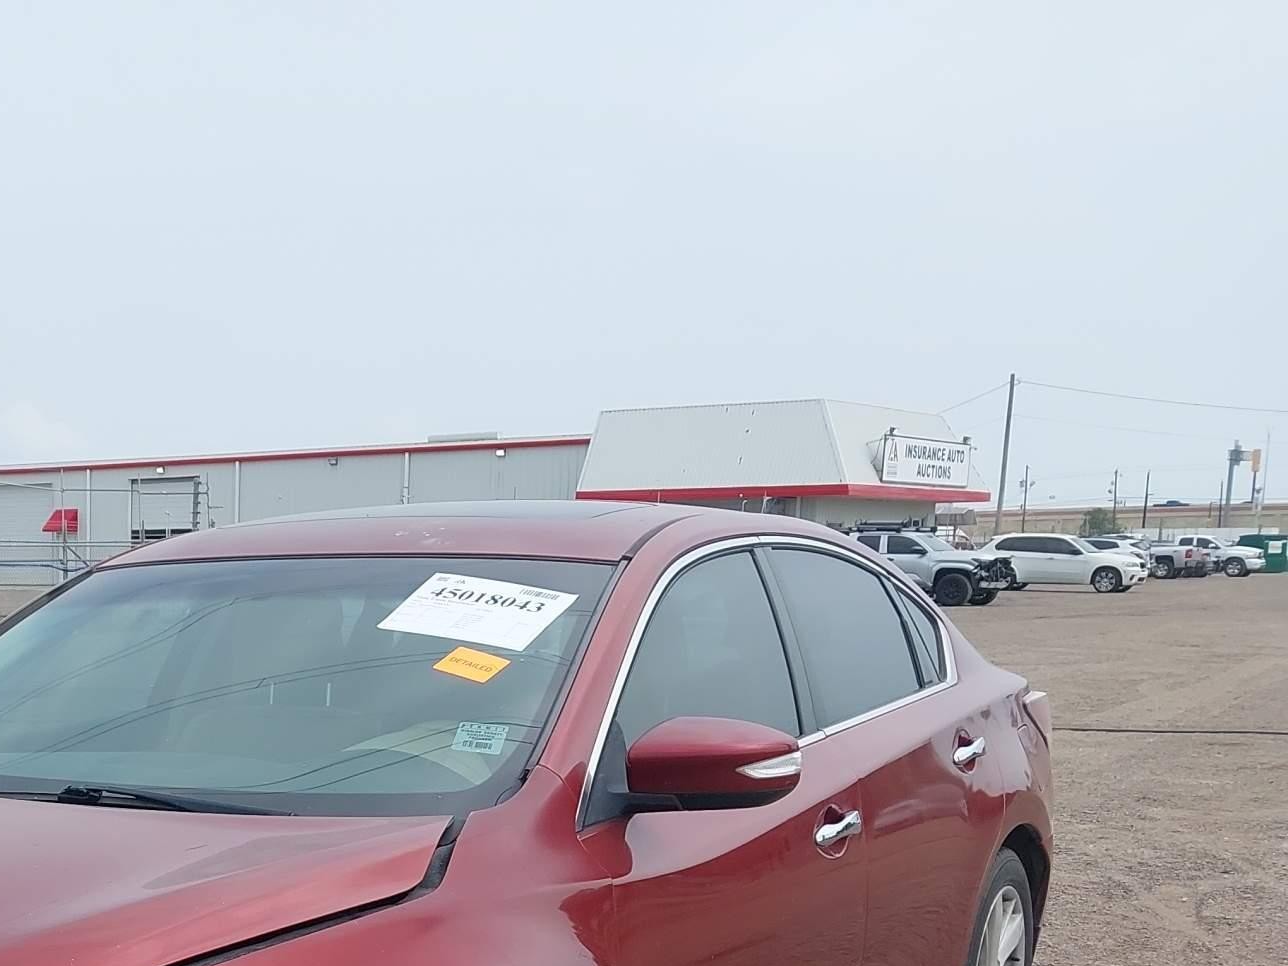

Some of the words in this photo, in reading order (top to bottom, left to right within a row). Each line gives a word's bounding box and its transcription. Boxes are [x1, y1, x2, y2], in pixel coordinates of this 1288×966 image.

[905, 444, 946, 461] INSURANCE
[947, 449, 965, 463] AUTO
[916, 464, 952, 480] AUCTIONS
[431, 587, 545, 612] 45018043
[448, 656, 493, 673] DETAILED
